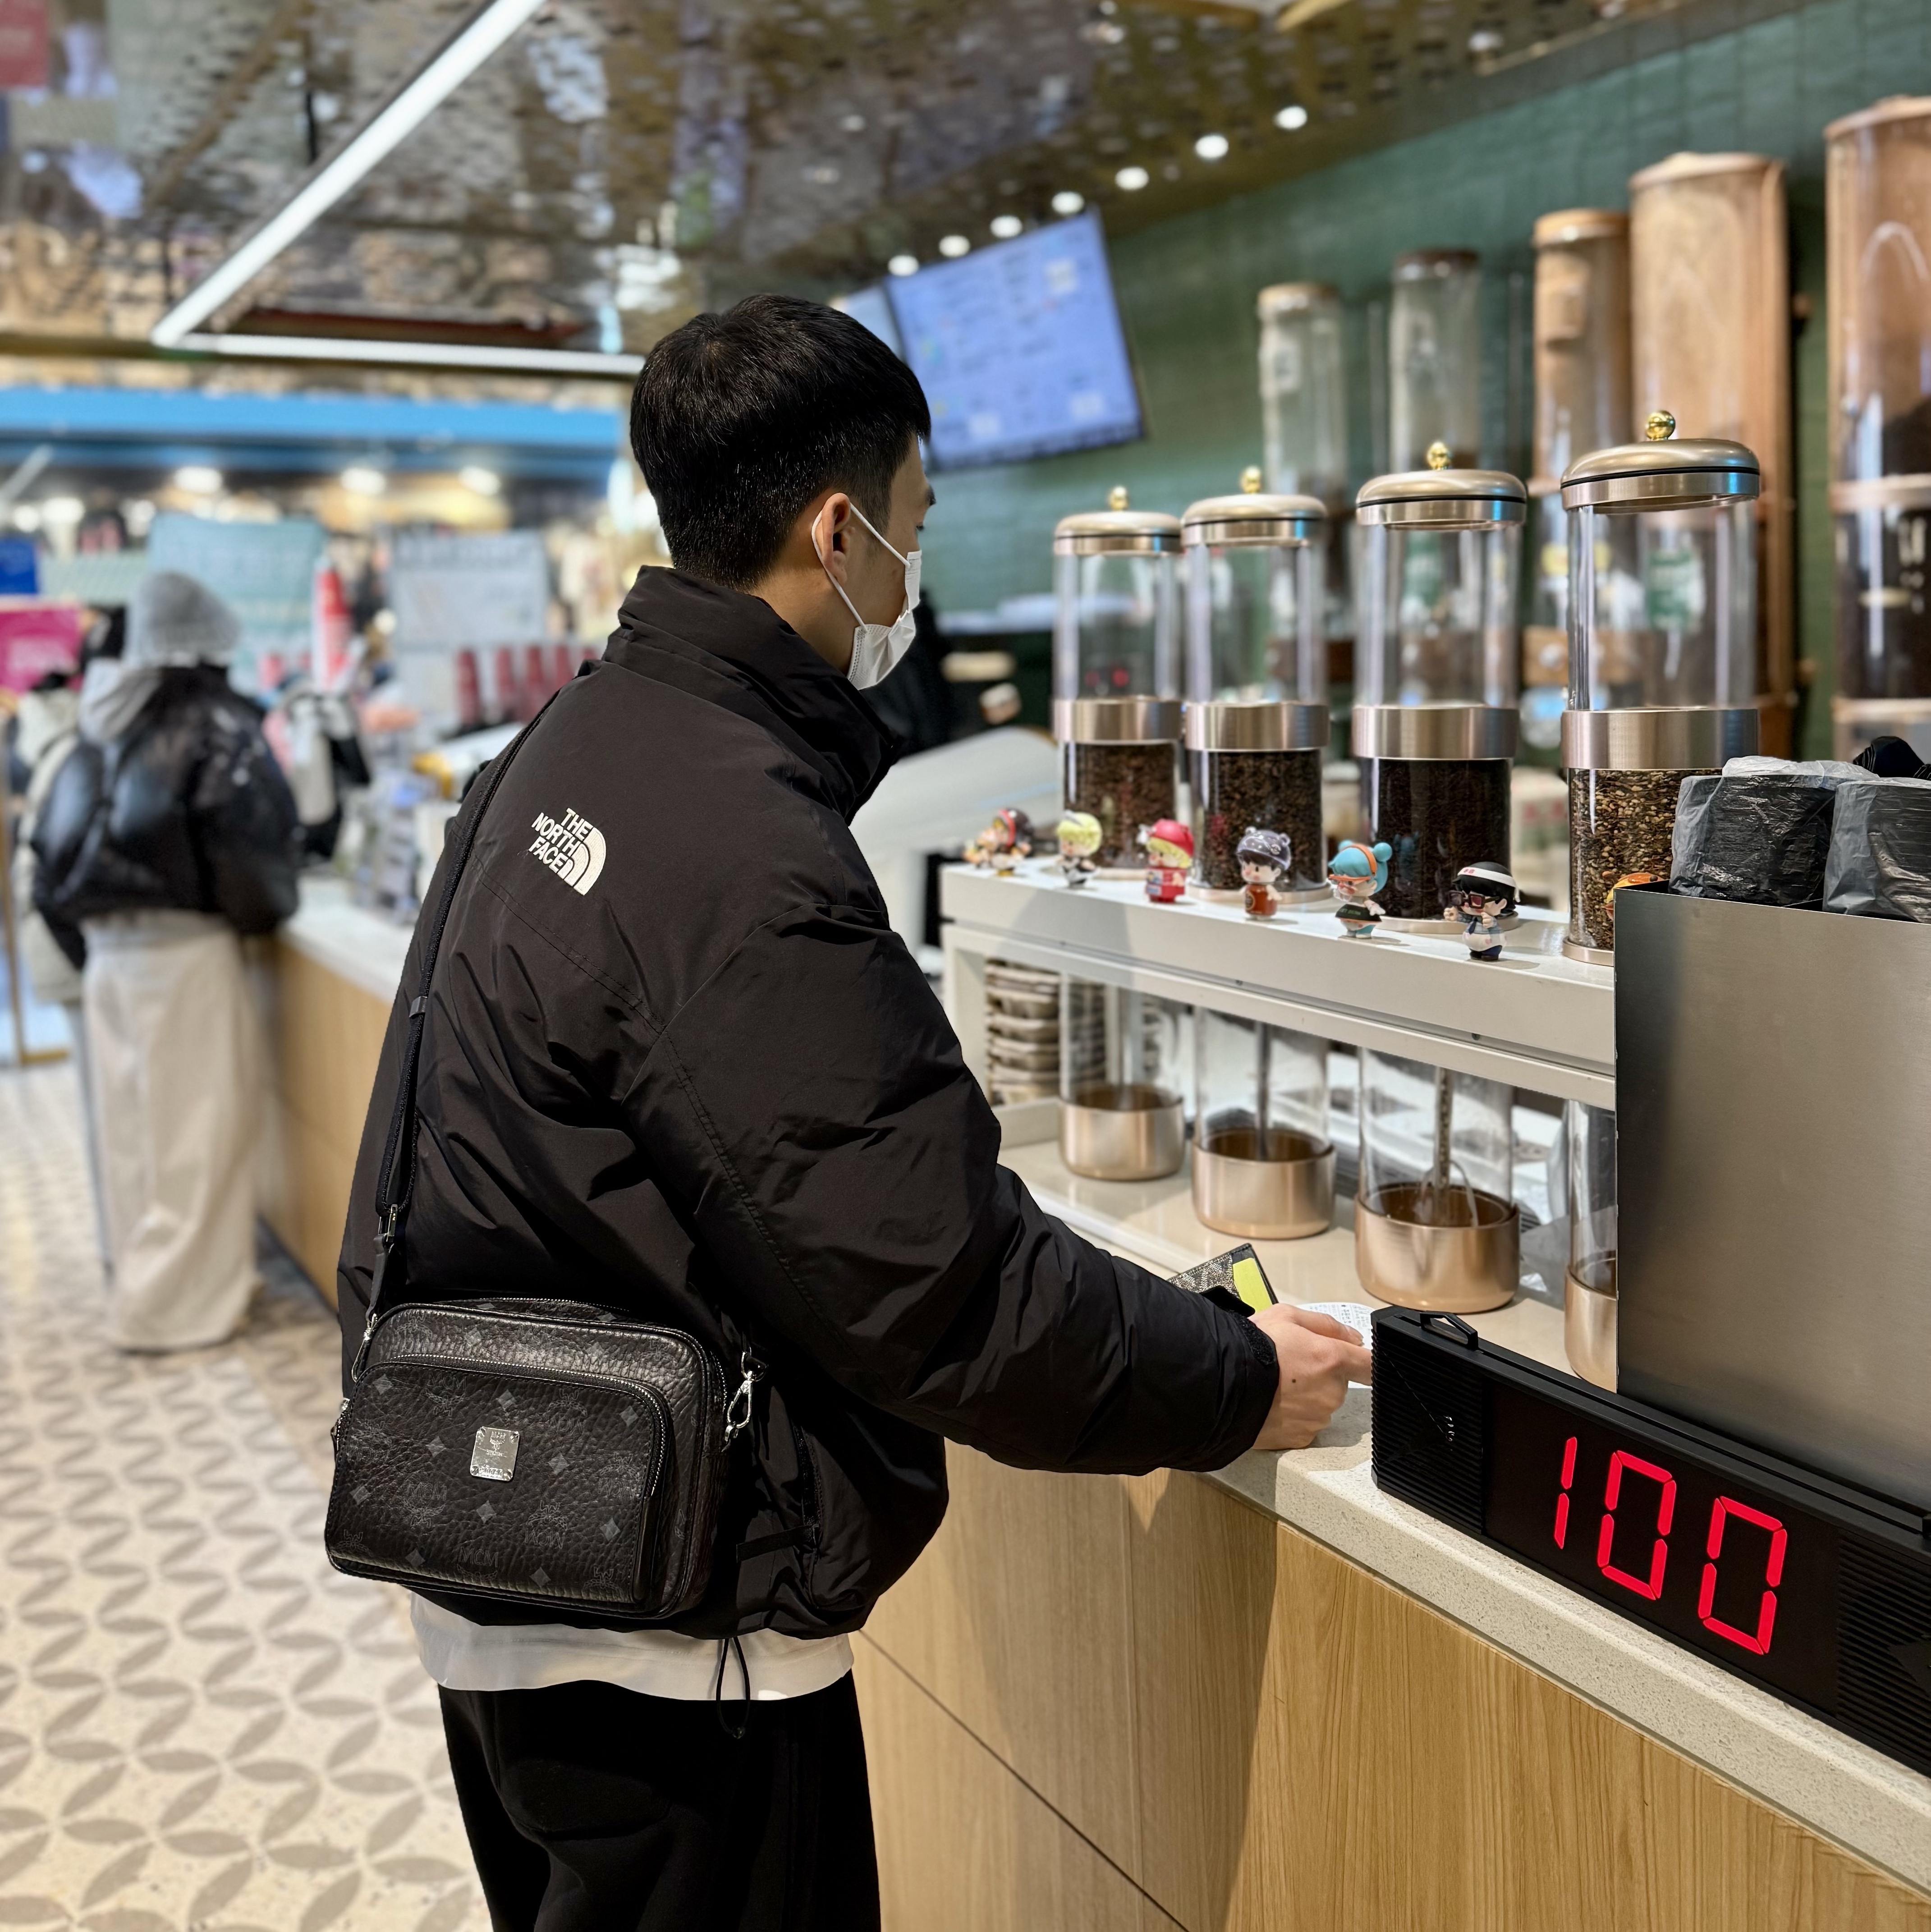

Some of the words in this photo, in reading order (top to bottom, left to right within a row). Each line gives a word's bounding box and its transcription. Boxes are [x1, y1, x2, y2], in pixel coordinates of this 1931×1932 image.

[531, 812, 581, 857] NORTH
[560, 808, 594, 842] THE
[528, 836, 569, 874] FACE
[458, 1547, 499, 1568] MCM
[1554, 1436, 1788, 1655] 100
